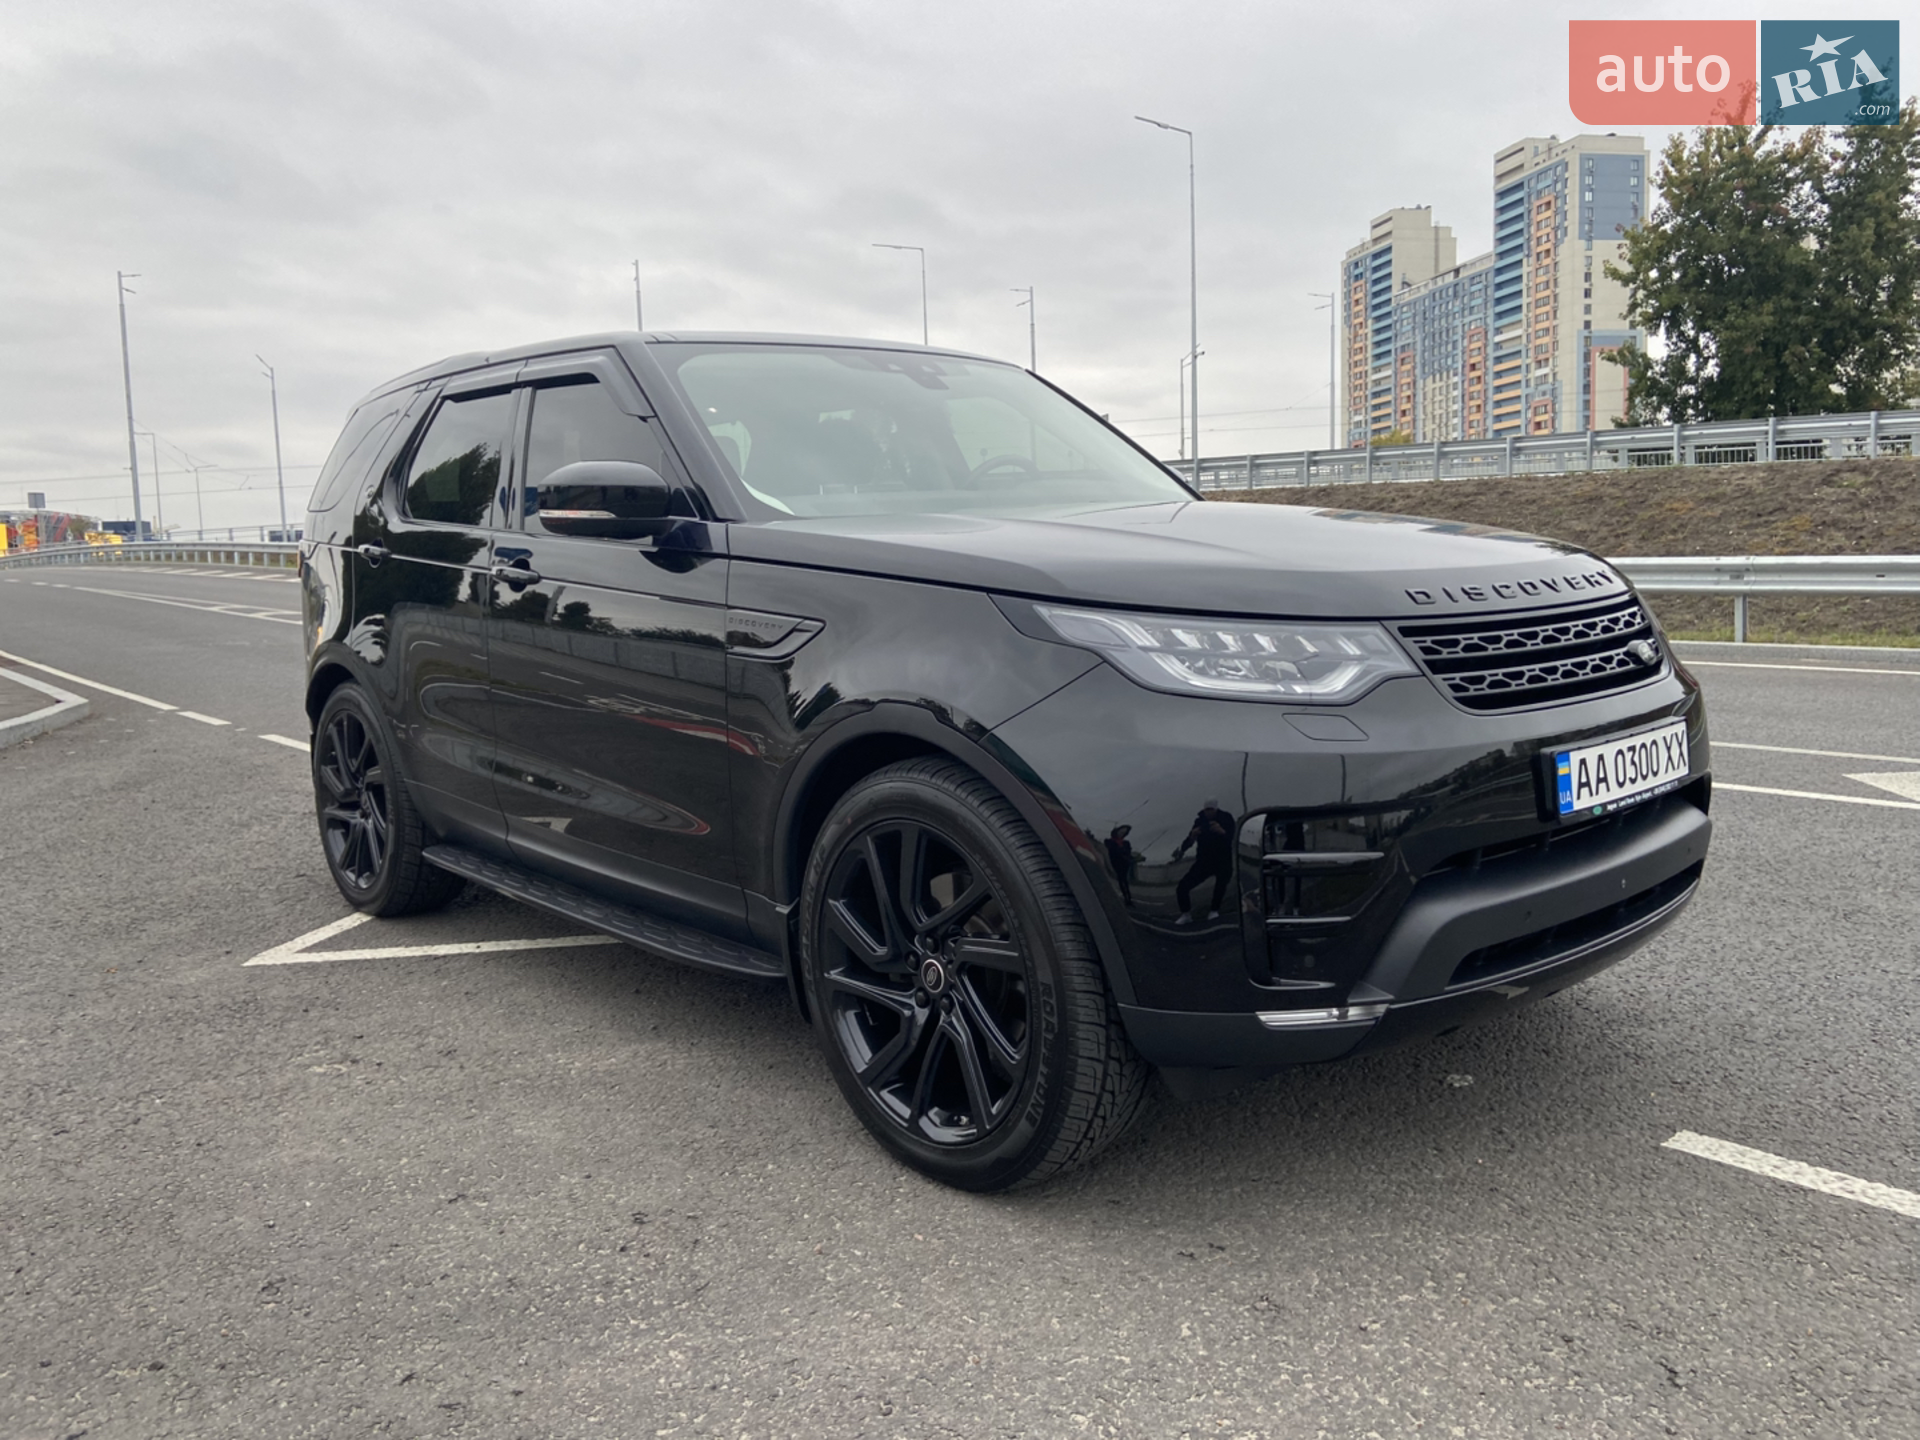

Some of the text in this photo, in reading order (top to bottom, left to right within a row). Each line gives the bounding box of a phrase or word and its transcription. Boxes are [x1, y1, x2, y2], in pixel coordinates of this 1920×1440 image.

[1404, 569, 1615, 606] DISCOVERY
[728, 617, 784, 630] DISCOVERY
[1576, 753, 1611, 801] AA
[1614, 739, 1660, 789] 0300
[1663, 730, 1687, 774] XX
[1559, 790, 1572, 804] UA
[1024, 981, 1055, 1132] ROADSTONE
